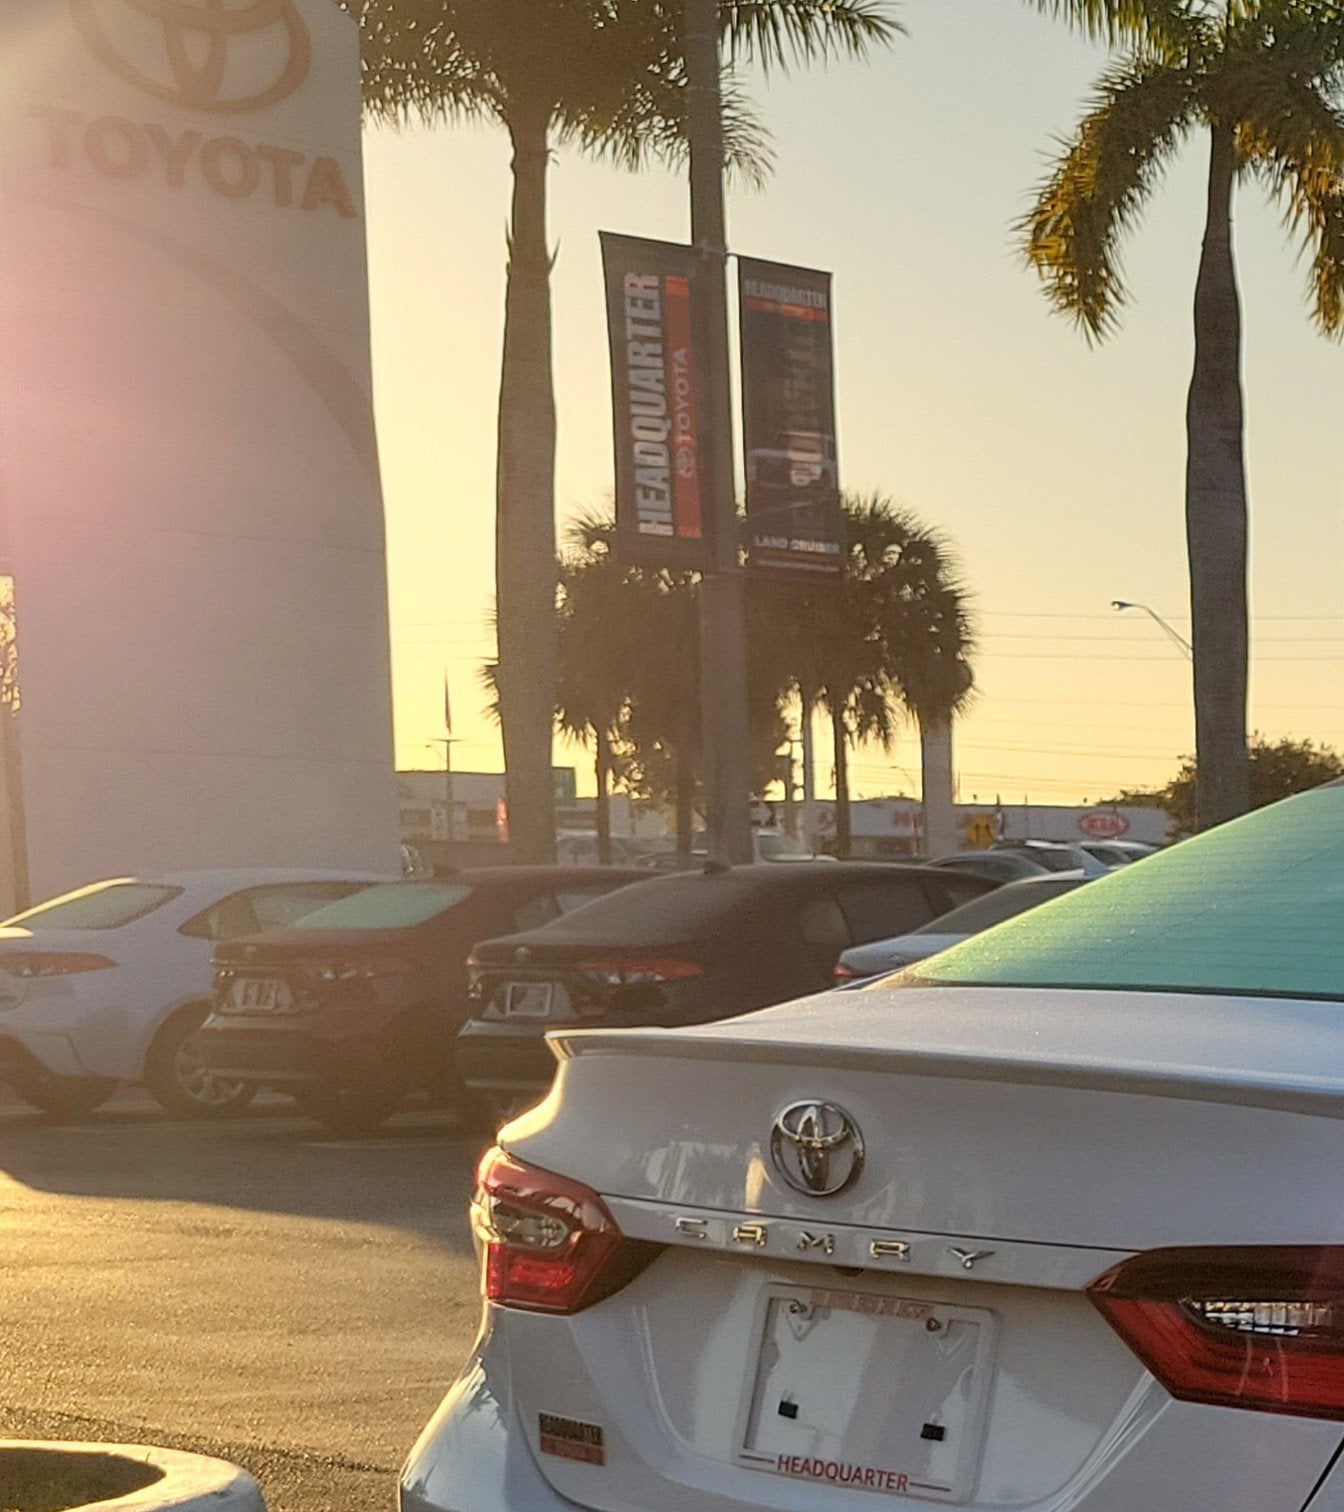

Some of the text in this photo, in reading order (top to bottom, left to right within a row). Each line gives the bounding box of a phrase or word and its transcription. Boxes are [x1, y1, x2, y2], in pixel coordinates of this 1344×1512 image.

[30, 108, 358, 219] TOYOTA
[623, 271, 674, 537] HEADQUARTER
[671, 348, 697, 446] TOYOTA
[754, 534, 788, 550] LAND
[675, 1216, 996, 1270] CAMRY
[776, 1453, 908, 1492] HEADQUARTER
